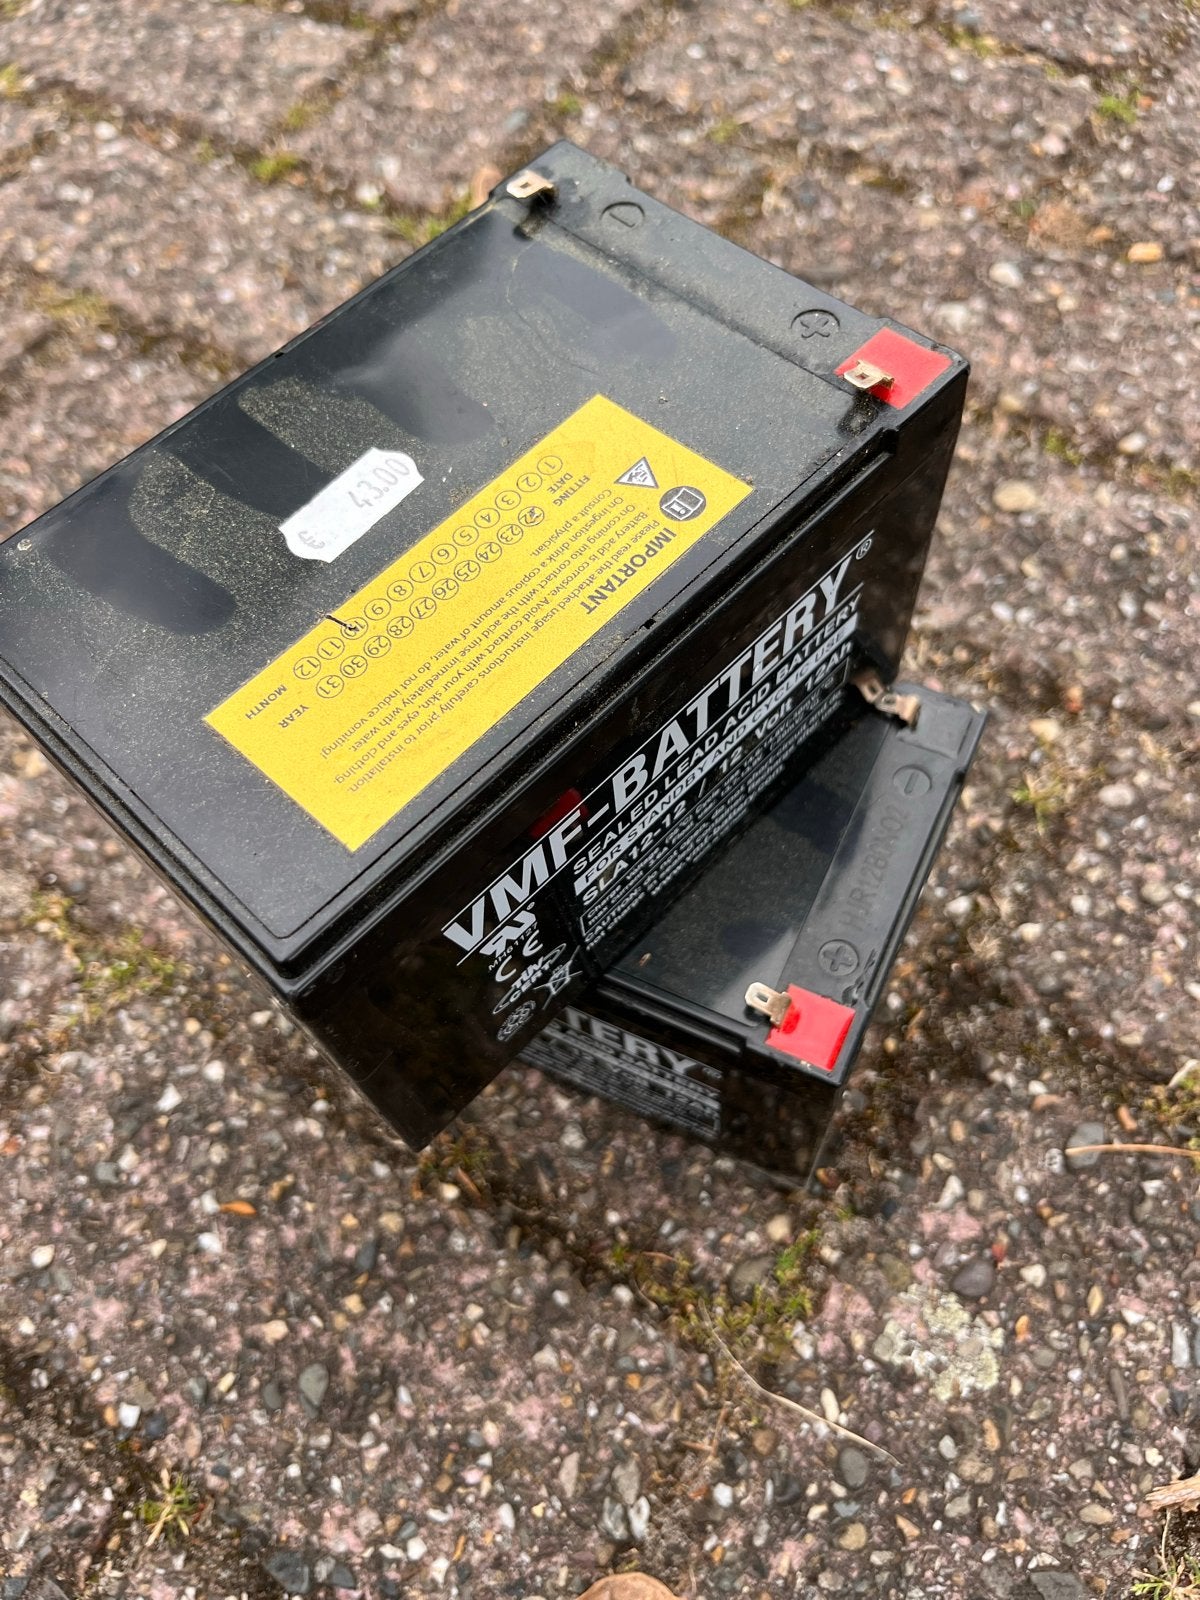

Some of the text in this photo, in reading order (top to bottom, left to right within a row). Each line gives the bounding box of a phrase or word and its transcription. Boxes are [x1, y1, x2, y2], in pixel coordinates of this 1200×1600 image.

[347, 457, 411, 508] 43.00
[546, 472, 573, 493] DATE
[552, 474, 590, 506] FITTING
[577, 488, 612, 517] Consult
[607, 496, 624, 508] On
[499, 524, 522, 542] 23
[529, 520, 572, 556] physician.
[568, 507, 611, 542] ingestion
[475, 542, 499, 560] 24
[545, 541, 570, 562] drink
[456, 560, 477, 581] 25
[504, 567, 540, 597] copious
[579, 527, 676, 614] IMPORTANT
[431, 578, 456, 600] 26
[414, 597, 436, 619] 27
[469, 596, 506, 628] amount
[348, 504, 635, 751] On coming into contact with the acid rinse immediately with water.
[386, 616, 411, 638] 28
[459, 627, 470, 640] of
[323, 640, 342, 657] 11
[333, 511, 648, 783] Battery acid is corrosive. Avoid contract with your skin, eyes and clothing.
[349, 519, 660, 791] Please read the attached usage instructions carefully prior to installation.
[363, 635, 388, 658] 29
[429, 637, 461, 660] water,
[294, 659, 320, 676] 12
[339, 656, 364, 678] 30
[399, 673, 417, 689] not
[417, 661, 431, 673] do
[318, 676, 340, 695] 31
[245, 684, 287, 719] MONTH
[278, 704, 309, 728] YEAR
[366, 688, 402, 717] induce
[321, 717, 368, 759] vomiting!
[573, 789, 658, 874] SEALED
[664, 731, 718, 790] LEAD
[722, 682, 770, 735] ACID
[775, 593, 860, 684] BATTERY
[584, 843, 621, 883] FOR
[627, 760, 706, 842] STANDBY
[711, 724, 746, 762] AND
[751, 662, 809, 723] CYCLIC
[814, 631, 843, 662] USE
[582, 800, 685, 905] SLA12-12
[719, 745, 742, 773] 12
[754, 697, 792, 738] Volt
[804, 641, 851, 690] 12Ah
[585, 886, 640, 942] CAUTION:
[643, 870, 657, 885] do
[659, 849, 677, 869] not
[587, 884, 621, 918] Charge
[625, 847, 659, 879] Voltage
[588, 906, 607, 925] max
[610, 870, 643, 903] current
[587, 930, 605, 950] not
[607, 891, 644, 929] charge
[488, 921, 537, 970] MH61127
[509, 959, 551, 1002] CERT
[511, 956, 544, 989] TÜV
[563, 1006, 698, 1076] TERY
